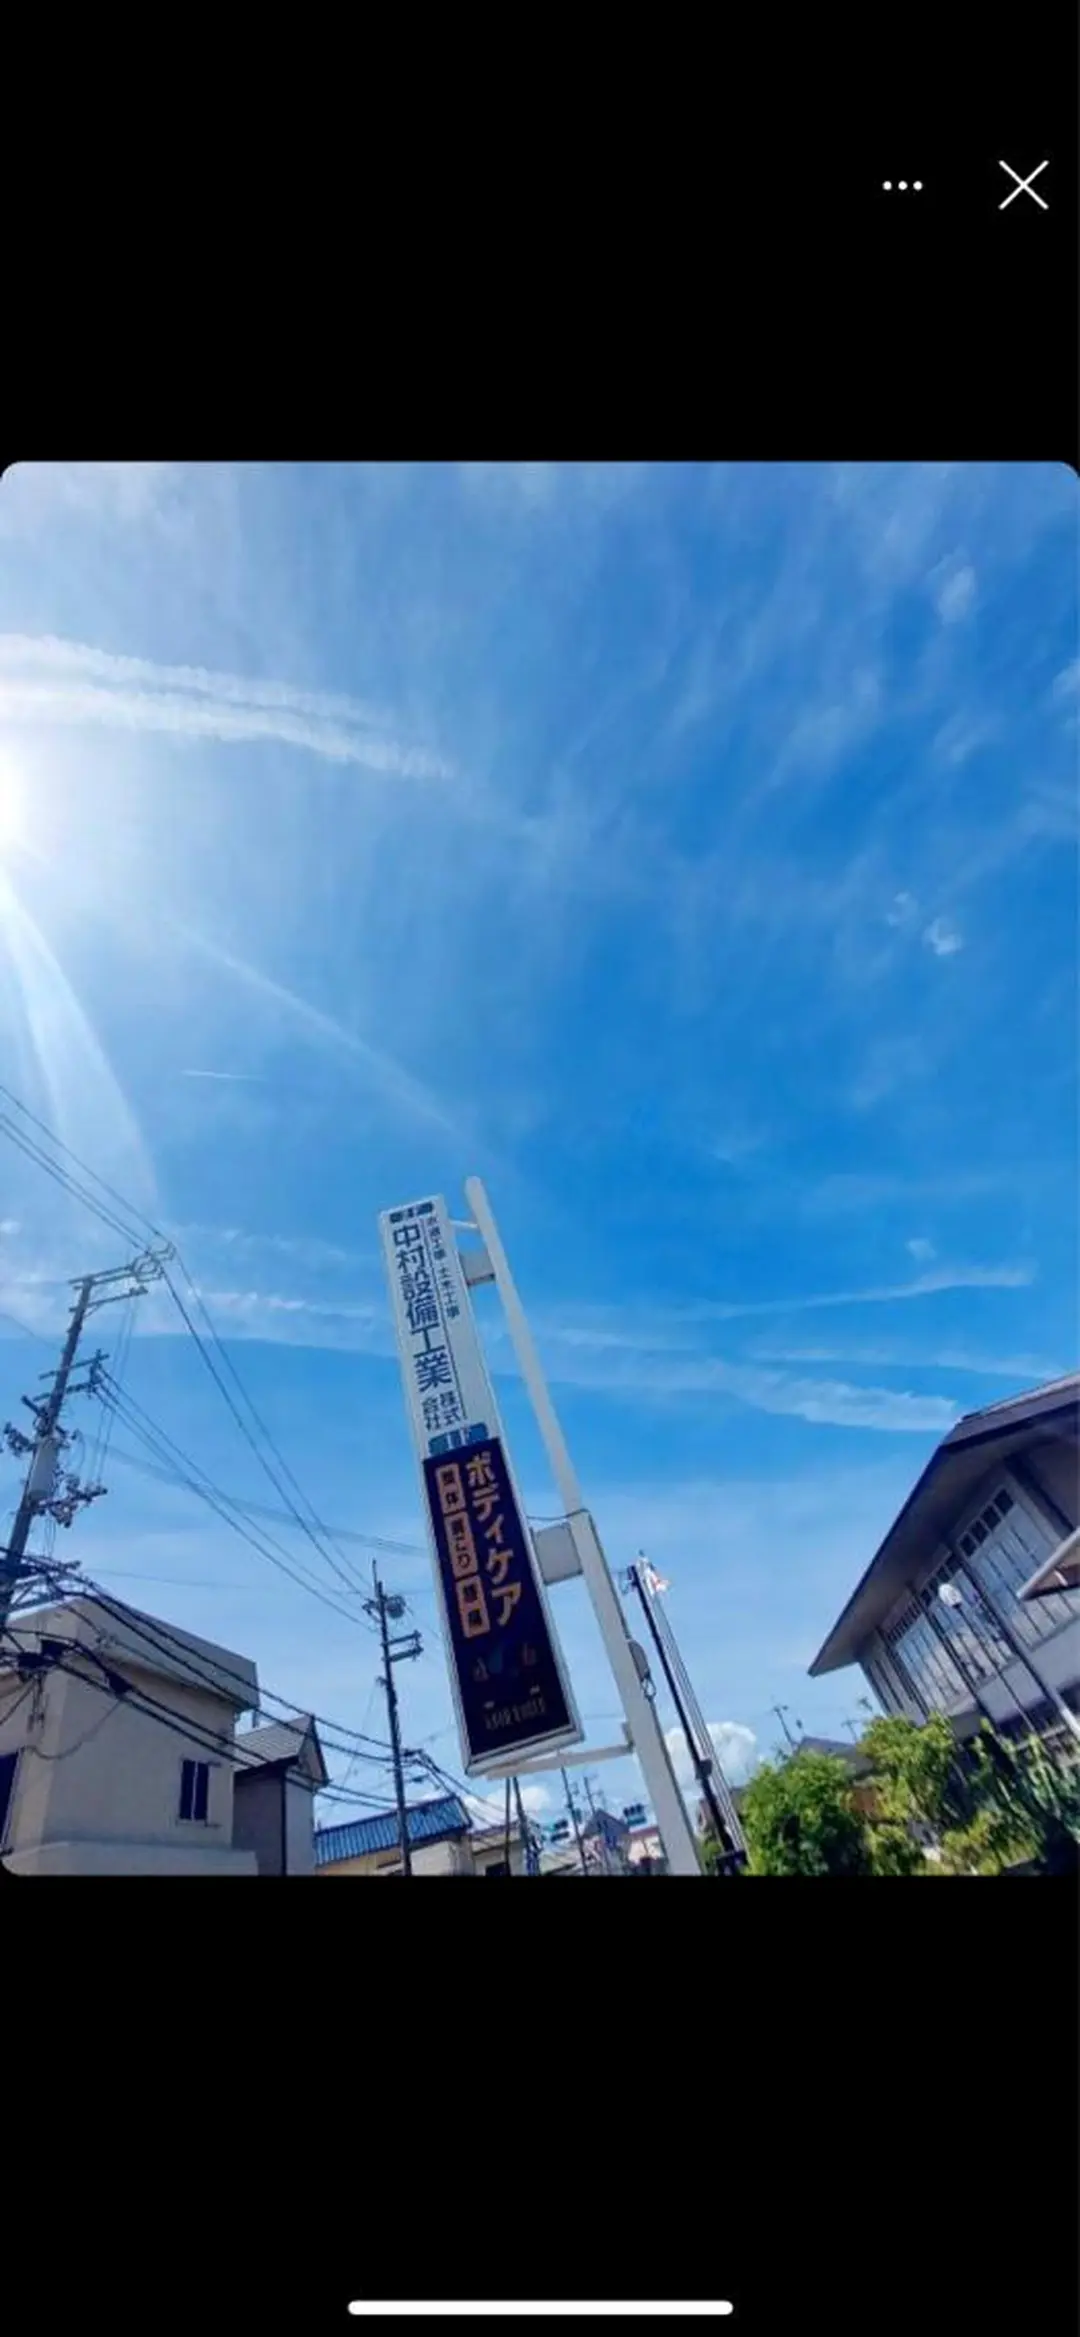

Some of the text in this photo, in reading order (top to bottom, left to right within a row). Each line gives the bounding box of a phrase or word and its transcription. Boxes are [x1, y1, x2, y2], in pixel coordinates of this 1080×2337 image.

[393, 1224, 452, 1393] 中村設備工業
